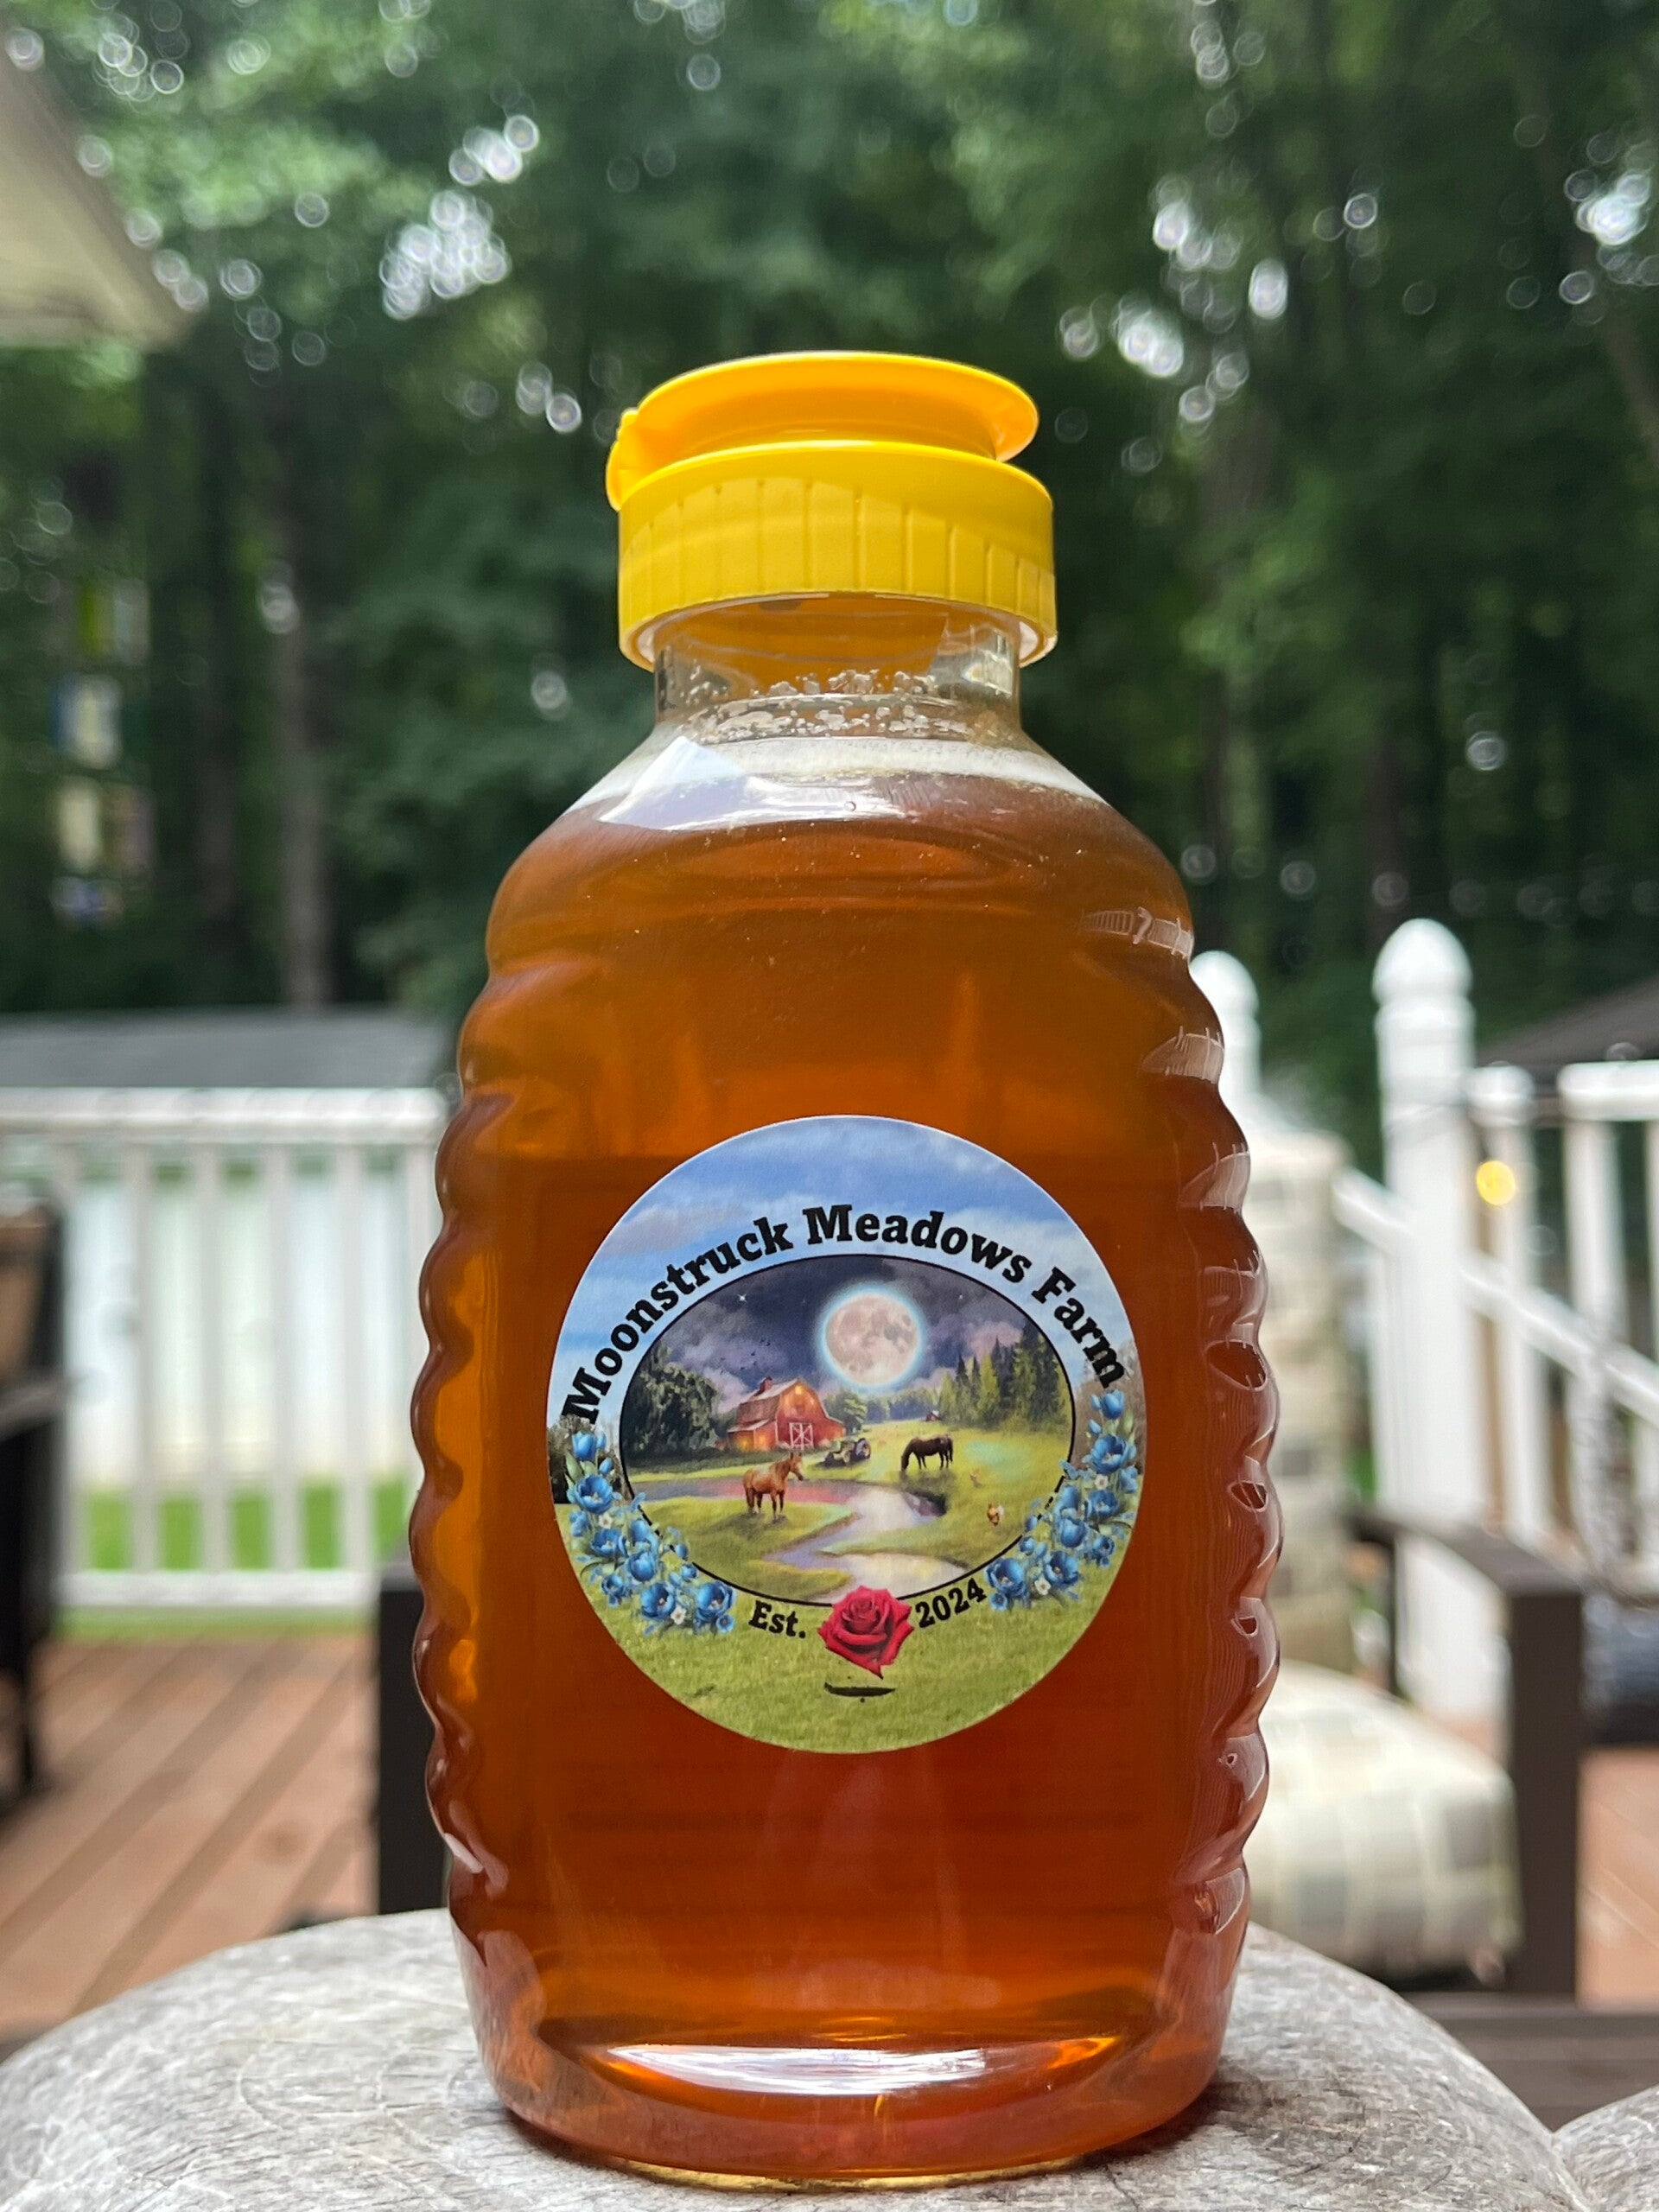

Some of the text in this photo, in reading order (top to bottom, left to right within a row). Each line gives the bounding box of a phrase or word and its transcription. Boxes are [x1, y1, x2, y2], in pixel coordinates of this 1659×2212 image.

[562, 1204, 1126, 1425] Moonstruck Meadows Farm
[748, 1577, 987, 1637] Est. 2024
